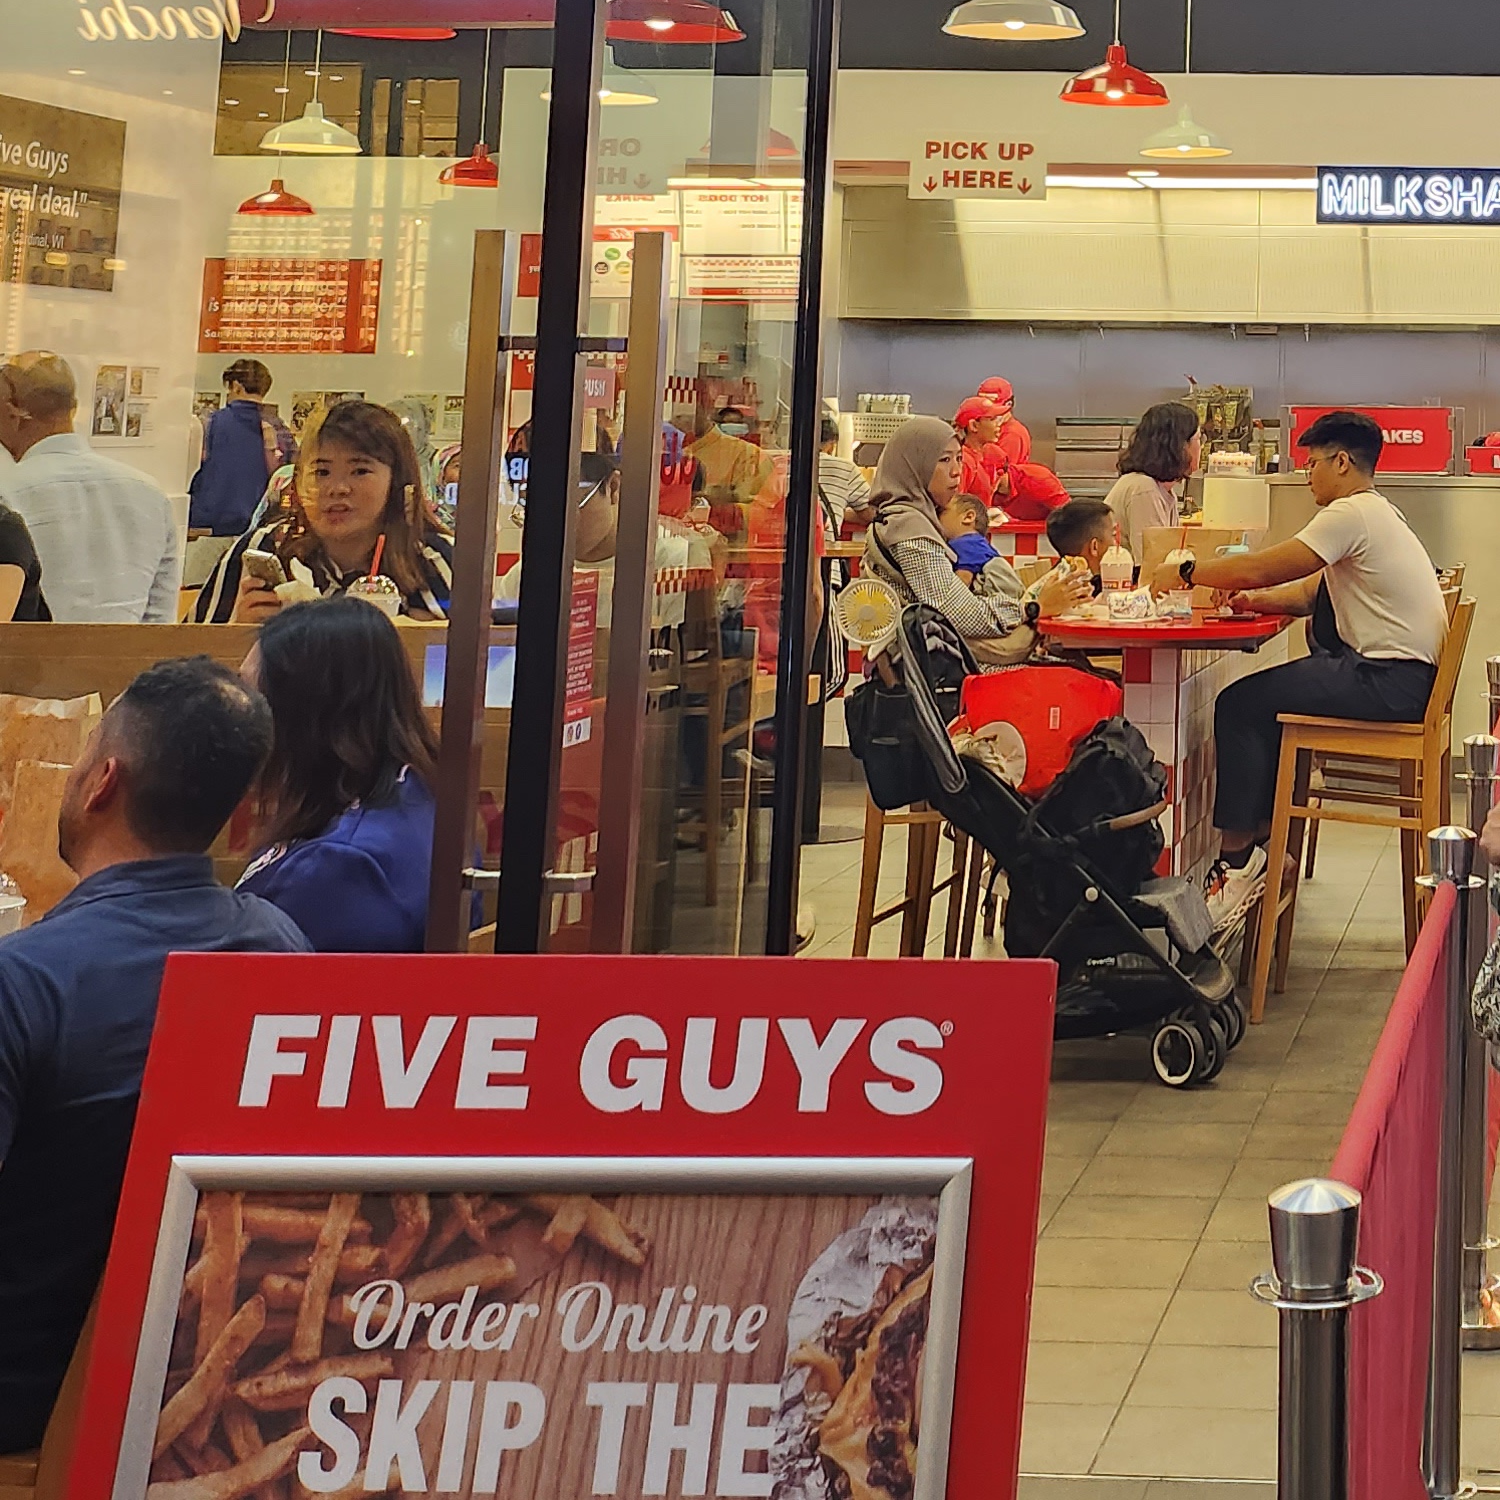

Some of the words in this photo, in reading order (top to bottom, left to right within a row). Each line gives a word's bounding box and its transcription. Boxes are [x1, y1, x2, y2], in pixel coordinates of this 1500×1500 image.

[0, 134, 22, 167] ive
[25, 141, 69, 178] Guys
[925, 141, 989, 160] PICK
[998, 143, 1034, 161] UP
[942, 170, 1014, 189] HERE
[39, 186, 88, 219] deal."
[237, 1014, 539, 1111] FIVE
[349, 1279, 540, 1352] Order
[556, 1281, 770, 1354] Online
[298, 1375, 547, 1496] SKIP
[585, 1382, 783, 1498] THE
